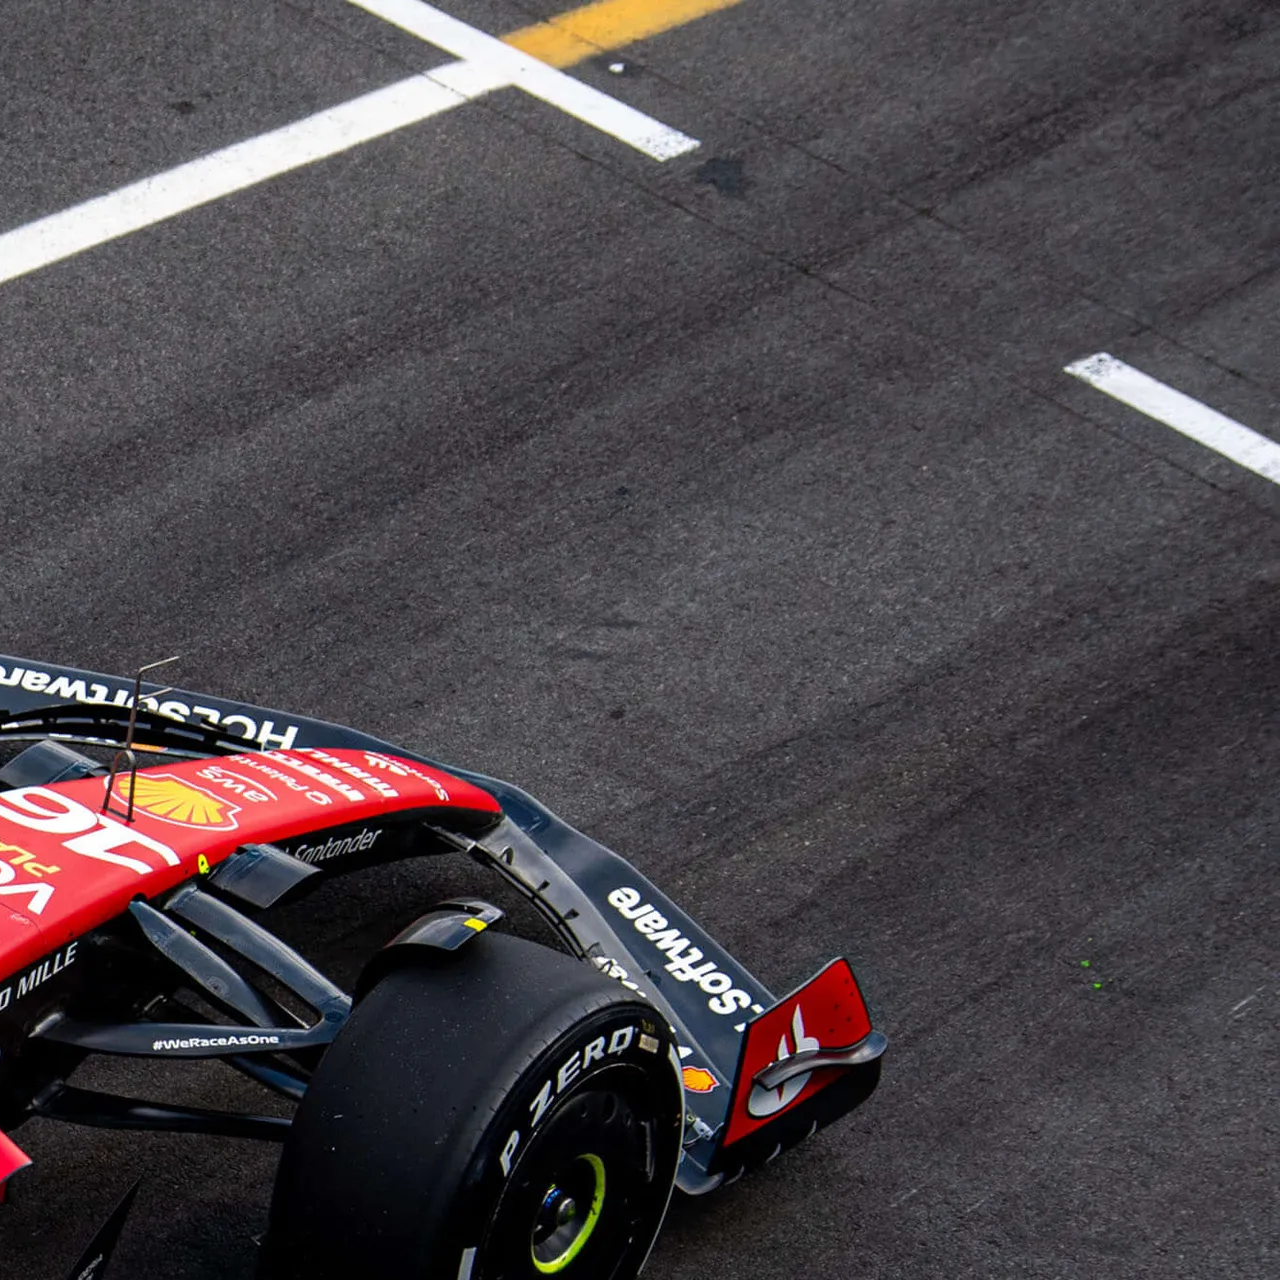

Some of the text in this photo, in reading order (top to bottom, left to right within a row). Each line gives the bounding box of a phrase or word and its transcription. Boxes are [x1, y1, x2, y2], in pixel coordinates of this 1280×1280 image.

[196, 768, 270, 803] aws
[16, 941, 79, 1000] MILLE
[153, 1035, 280, 1051] #WeRaceAsOne
[499, 1130, 520, 1177] P
[529, 1025, 635, 1128] ZERO
